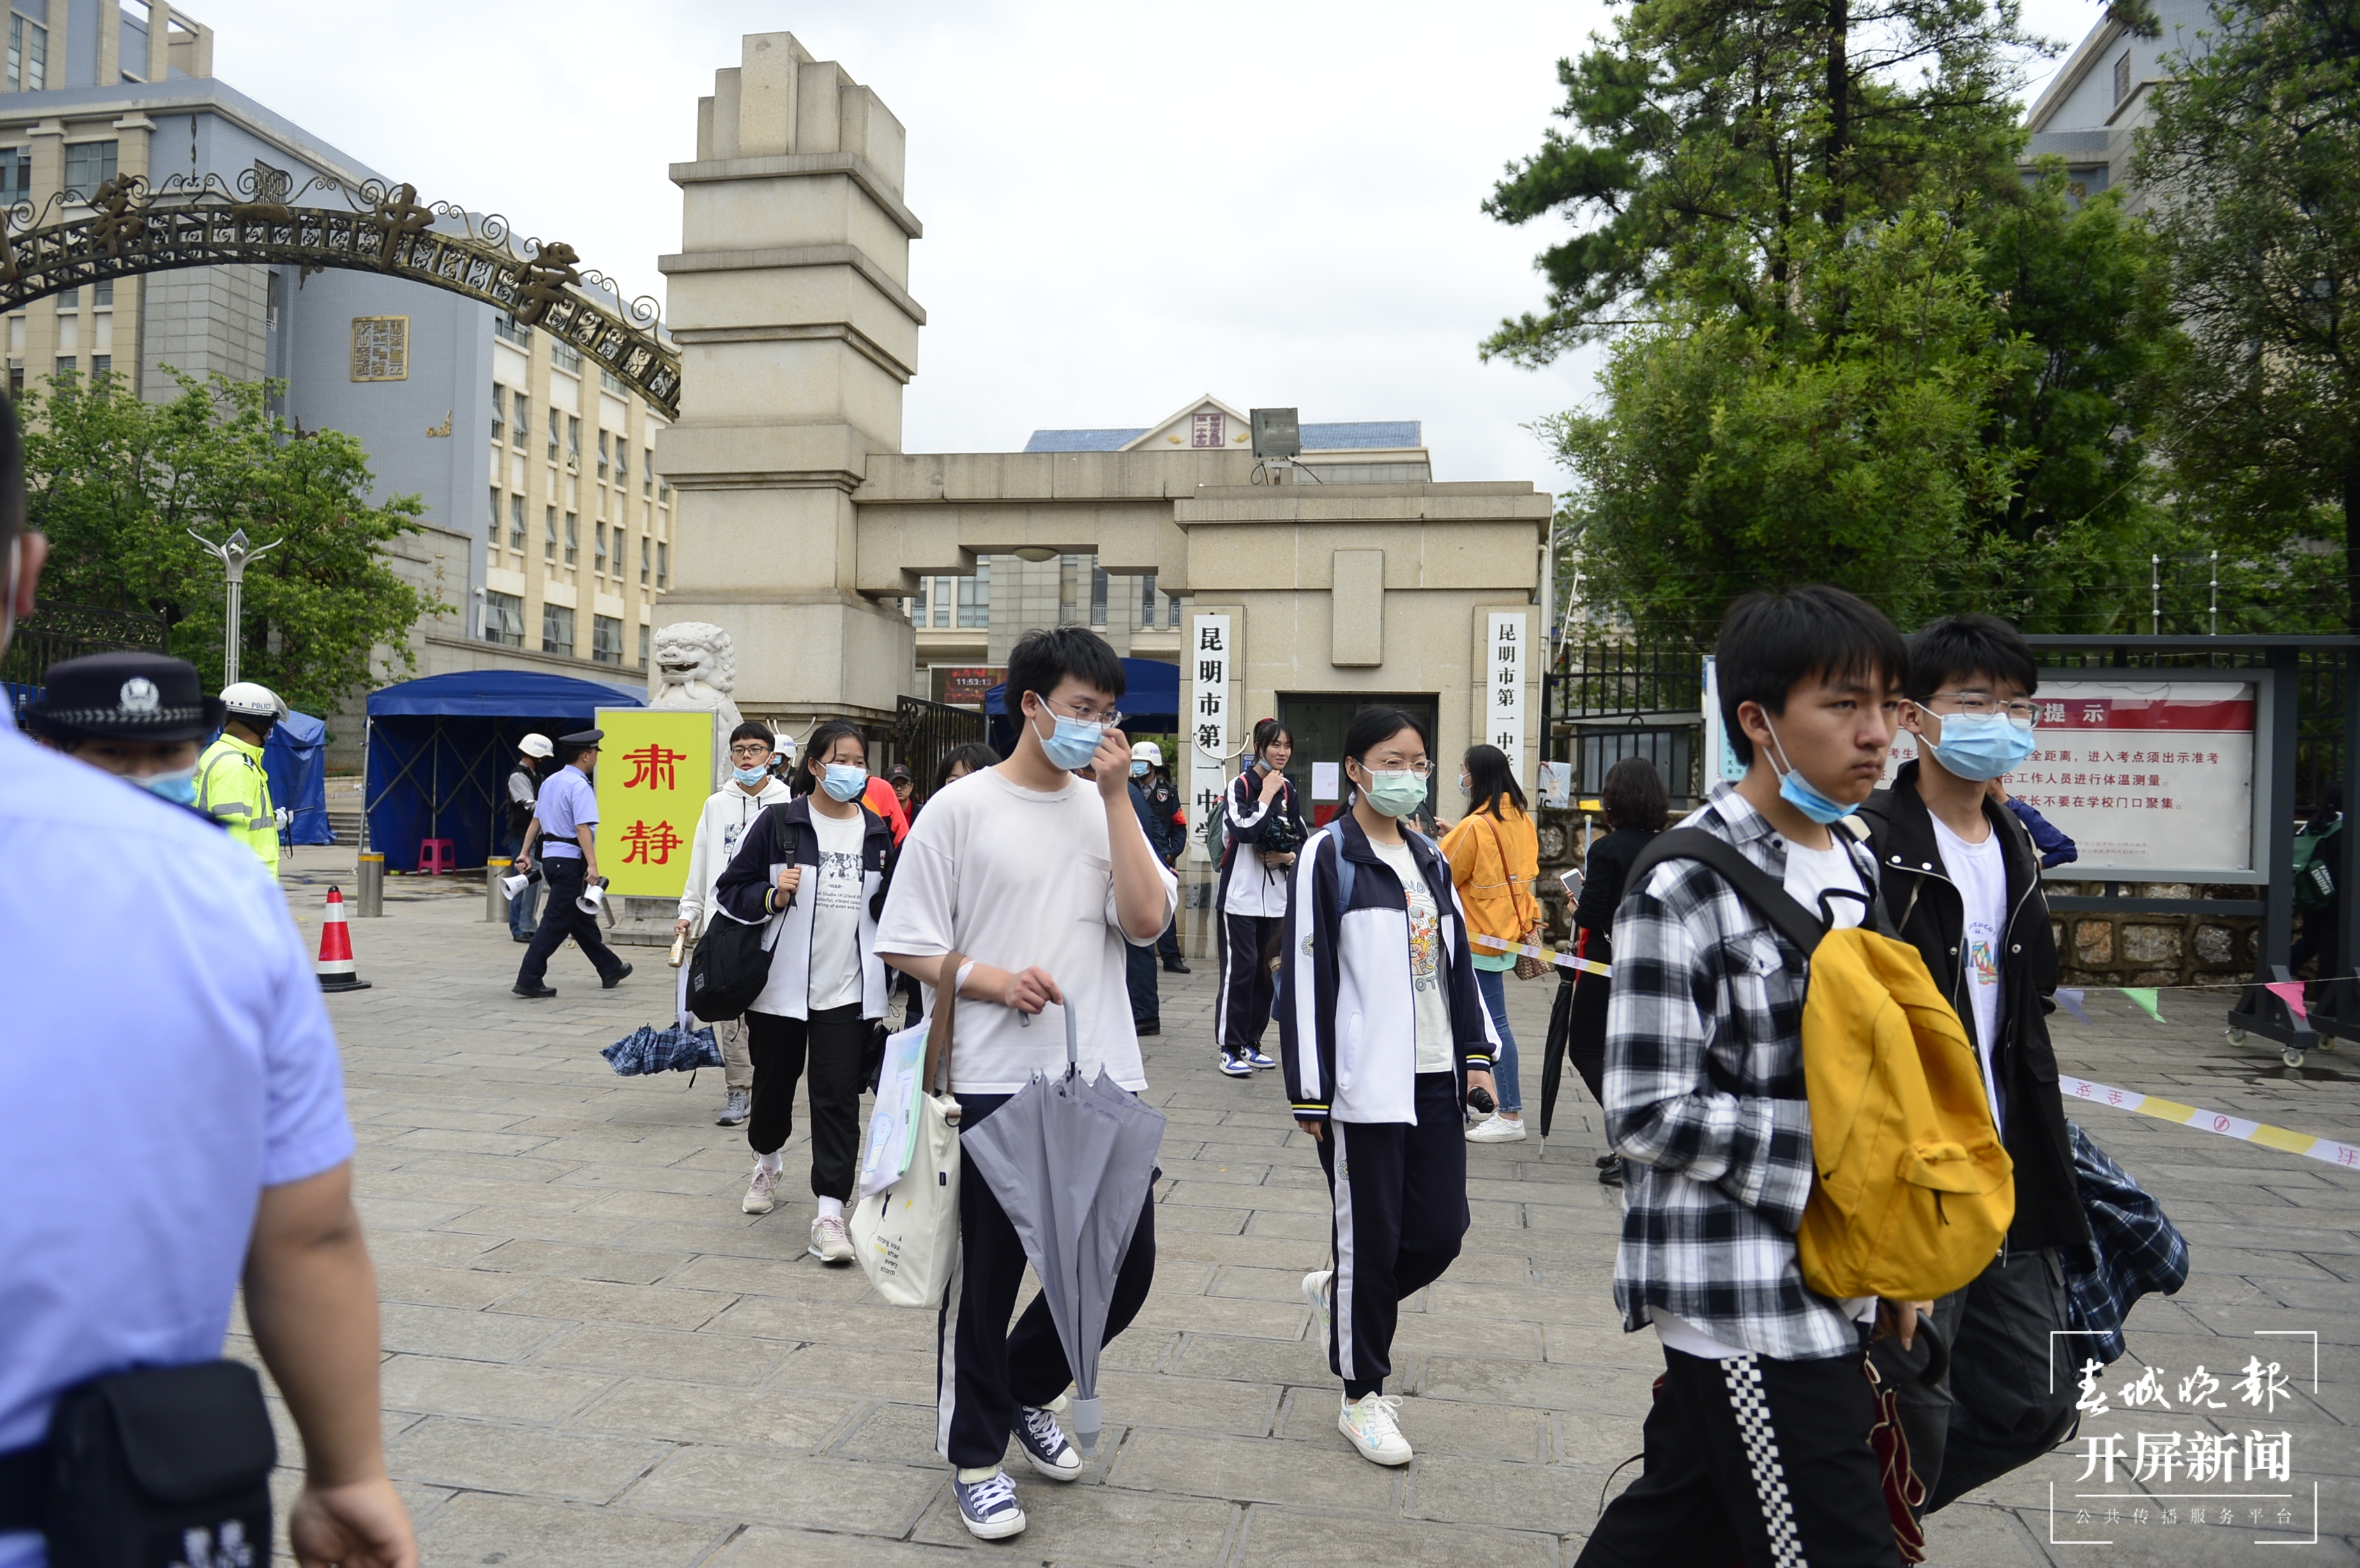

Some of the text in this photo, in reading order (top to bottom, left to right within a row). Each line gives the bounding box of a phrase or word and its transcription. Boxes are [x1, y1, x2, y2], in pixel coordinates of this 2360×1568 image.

[1496, 623, 1517, 767] 昆明市第一中
[2043, 702, 2105, 723] 提示
[1888, 747, 2220, 765] 考生 全距离，进入考点须出示准考
[620, 743, 687, 864] 肃静
[884, 1259, 898, 1269] every
[887, 1251, 899, 1259] after
